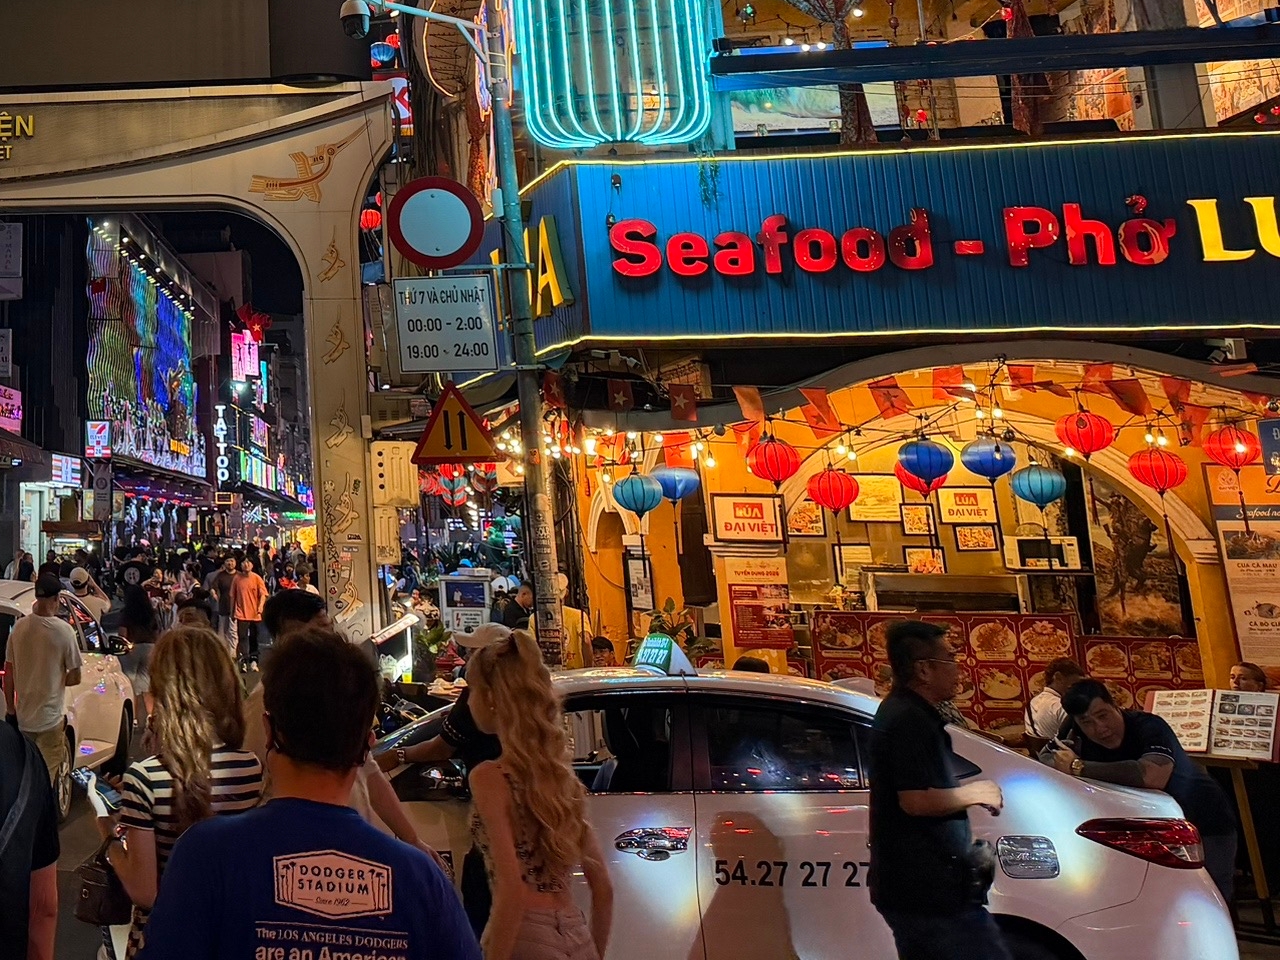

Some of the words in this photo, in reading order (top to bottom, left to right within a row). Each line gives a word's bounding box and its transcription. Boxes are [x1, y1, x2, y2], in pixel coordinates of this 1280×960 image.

[608, 206, 934, 278] Seafood
[1002, 194, 1177, 268] Phở
[419, 291, 425, 304] 7
[427, 286, 439, 304] VÀ
[440, 284, 458, 303] CHỦ
[460, 286, 485, 305] NHẬT
[407, 318, 442, 332] 00:00
[455, 316, 483, 331] 2:00
[406, 344, 439, 359] 19:00
[453, 342, 489, 357] 24:00
[214, 404, 230, 482] TATTOO
[955, 494, 978, 506] LÚA
[735, 505, 762, 518] LÚA
[948, 508, 965, 519] ĐẠI
[967, 507, 989, 519] VIỆT
[1236, 507, 1271, 519] Safood
[724, 521, 745, 534] ĐẠI
[748, 520, 776, 536] VIỆT
[299, 864, 365, 880] DODGER
[715, 860, 788, 887] 54.27
[799, 861, 832, 887] 27
[842, 861, 871, 888] 27
[297, 878, 369, 895] STADIUM
[333, 897, 350, 907] 1962
[255, 927, 276, 939] The
[278, 929, 299, 940] LOS
[301, 931, 353, 945] ANGELES
[355, 935, 408, 949] DODGERS
[255, 945, 285, 960] are
[289, 948, 313, 960] an
